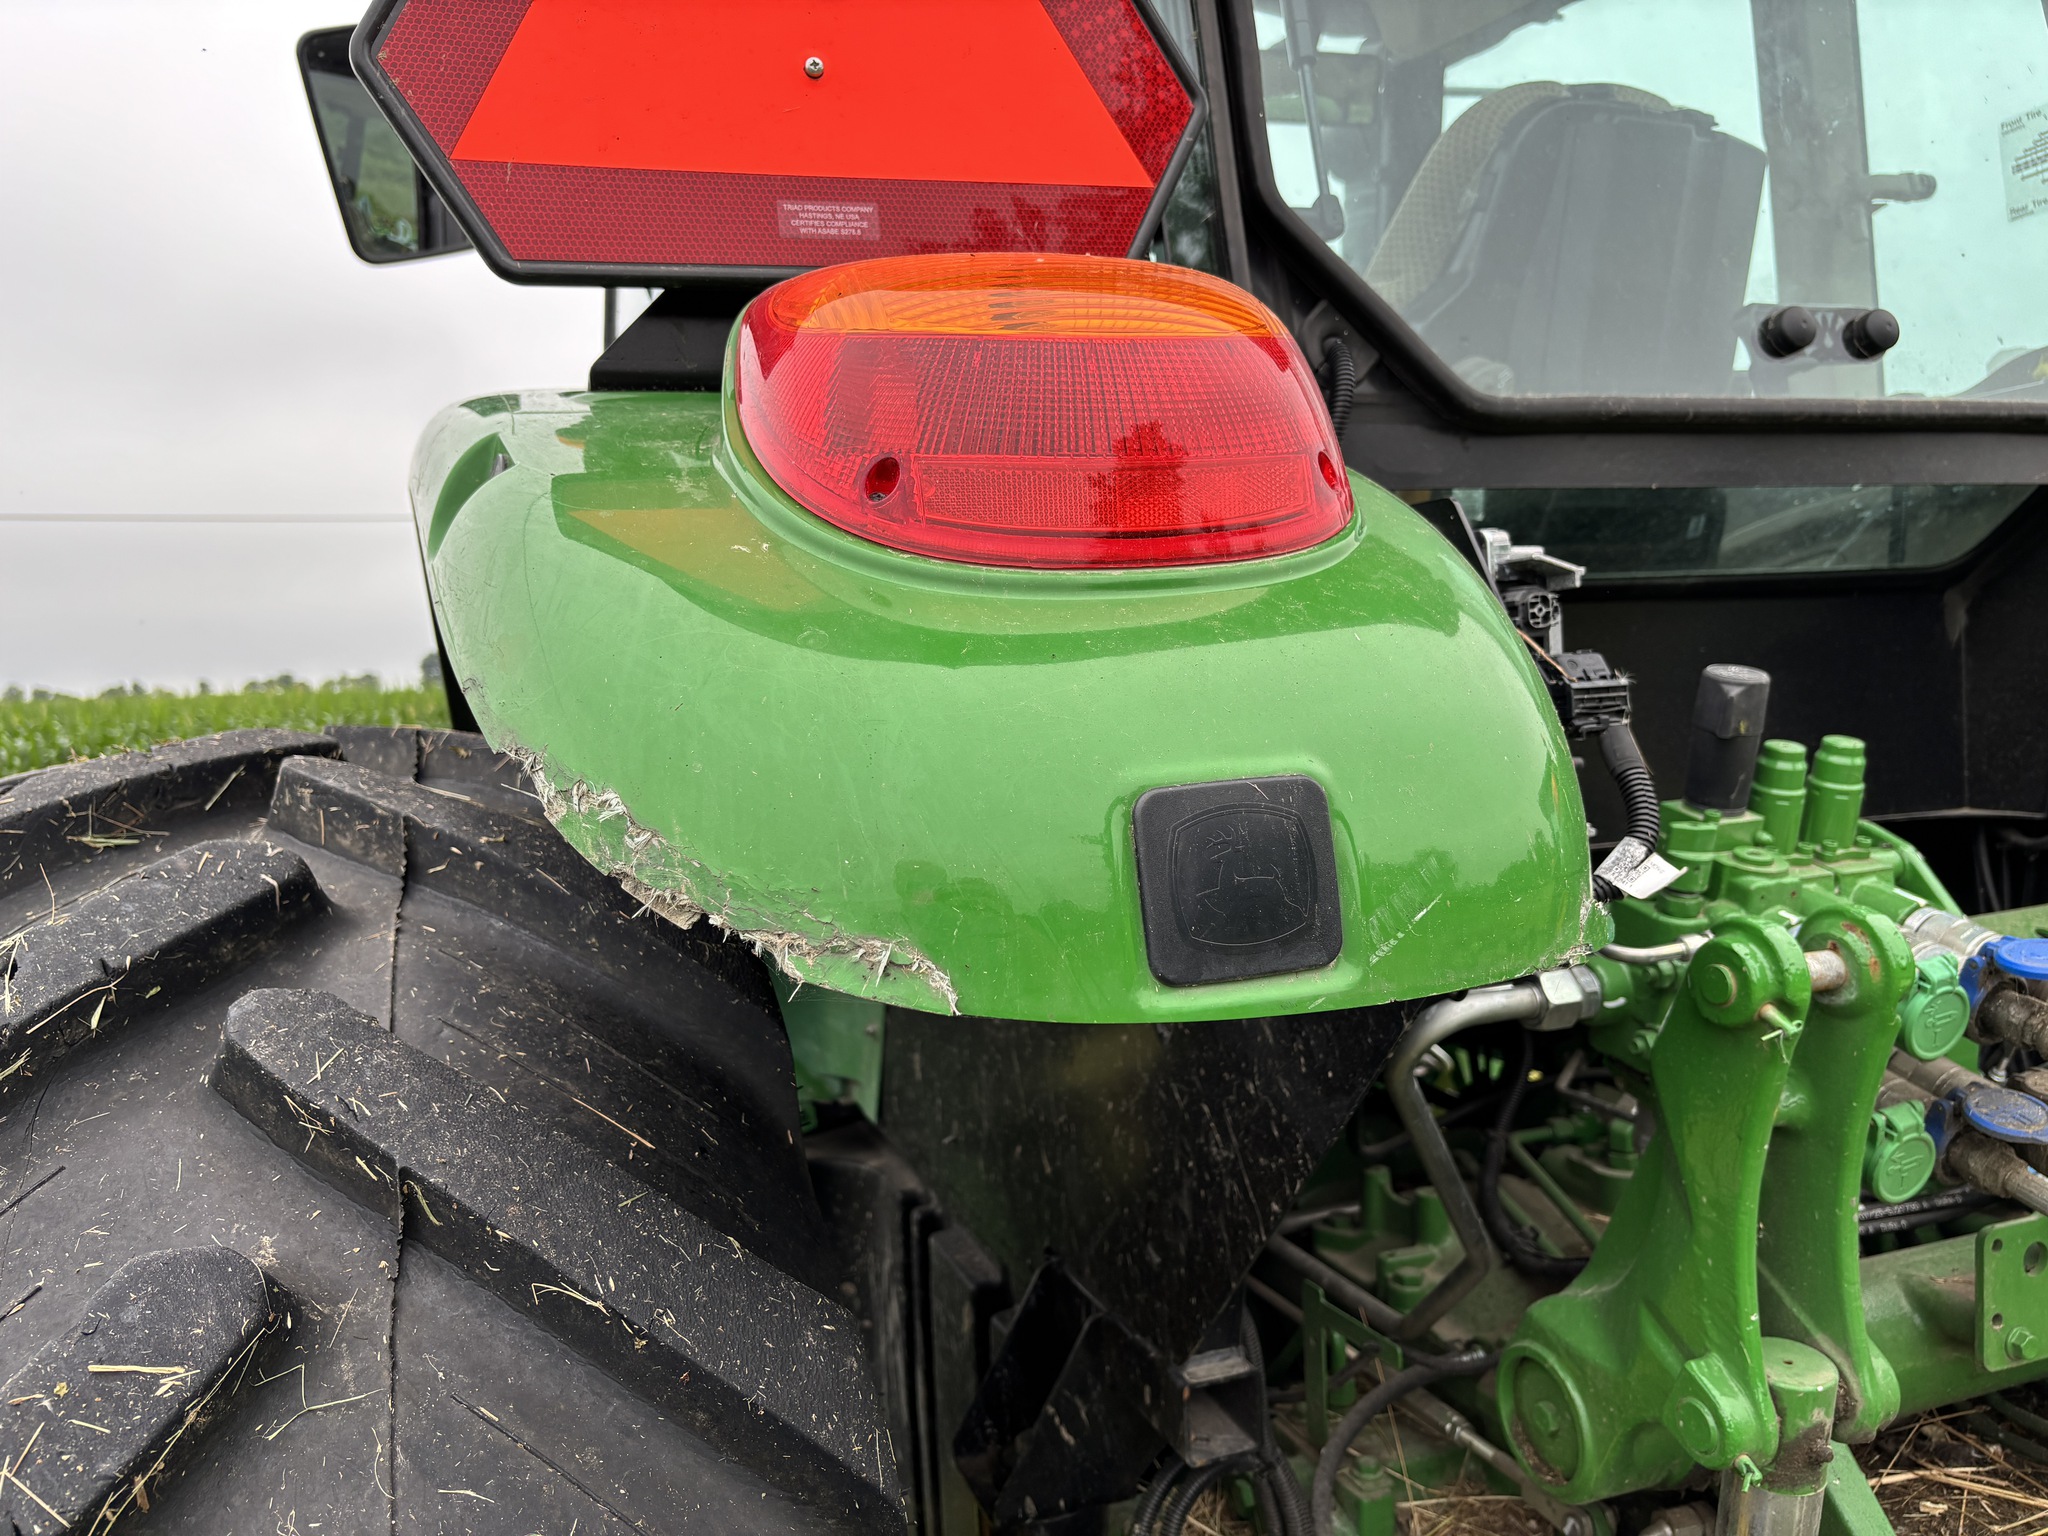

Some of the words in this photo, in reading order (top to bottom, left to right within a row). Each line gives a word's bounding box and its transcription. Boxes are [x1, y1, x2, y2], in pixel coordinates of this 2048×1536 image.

[2001, 116, 2022, 130] Front
[2026, 109, 2042, 121] Tire
[2009, 203, 2028, 216] Rear
[799, 212, 834, 220] HASTINGS,
[826, 220, 869, 228] COMPLIANCE
[799, 227, 817, 235] WITH
